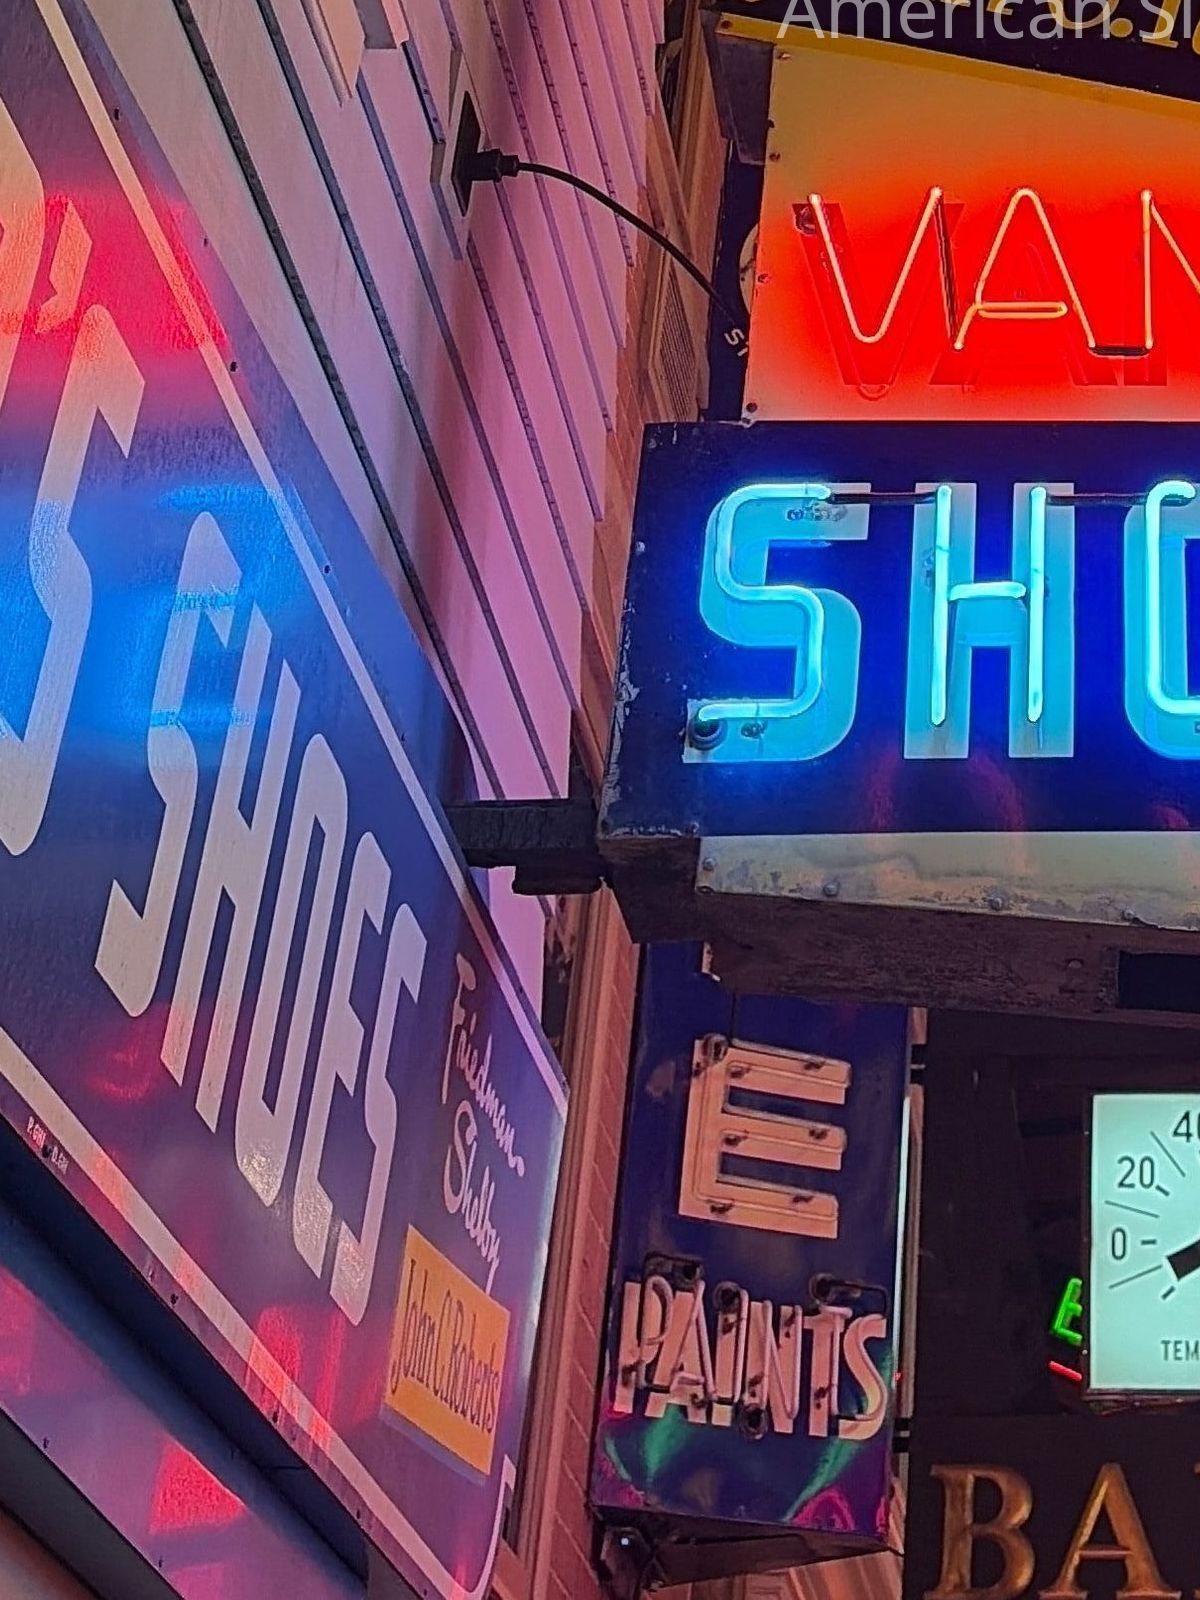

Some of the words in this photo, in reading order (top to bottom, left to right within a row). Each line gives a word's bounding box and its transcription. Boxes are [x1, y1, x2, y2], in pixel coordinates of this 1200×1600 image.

[95, 510, 427, 1326] SHOES
[442, 1099, 501, 1296] Shelby
[1110, 1226, 1127, 1261] 0
[1117, 1155, 1155, 1189] 20
[388, 1257, 436, 1396] John
[449, 1299, 500, 1435] Roberts
[611, 1272, 889, 1442] PAINTS
